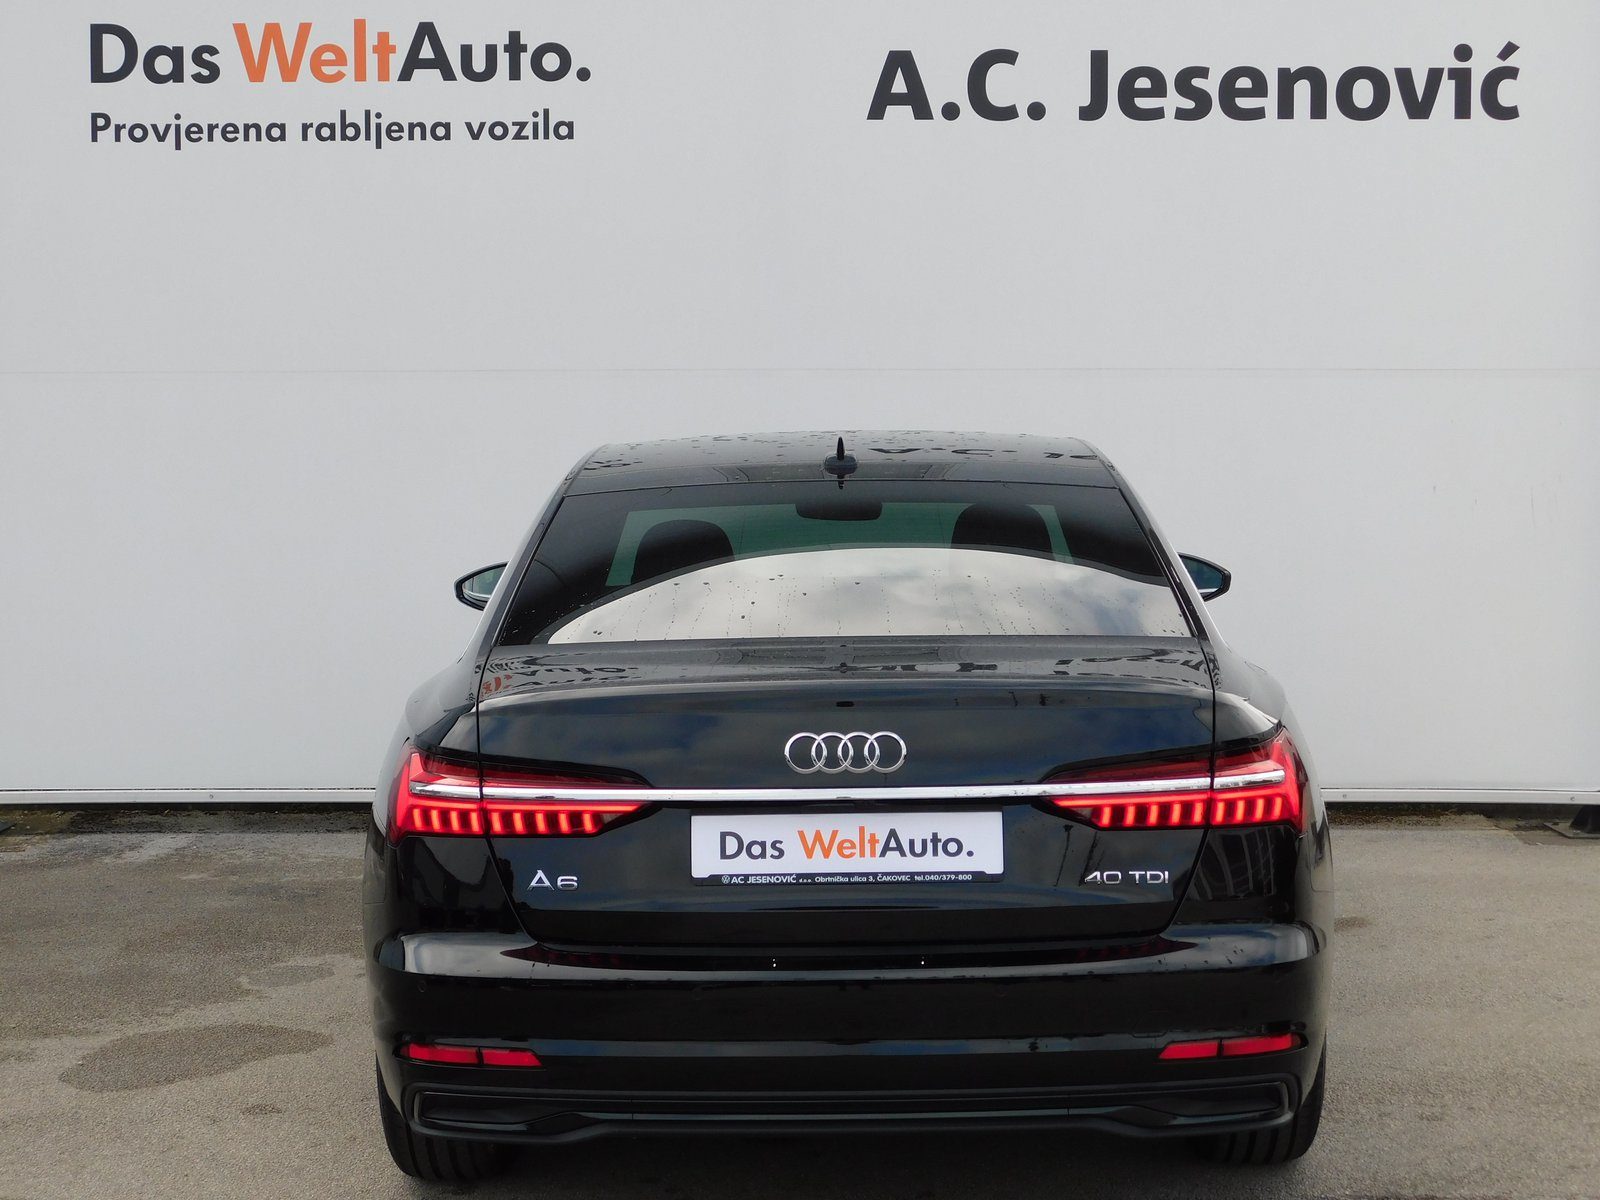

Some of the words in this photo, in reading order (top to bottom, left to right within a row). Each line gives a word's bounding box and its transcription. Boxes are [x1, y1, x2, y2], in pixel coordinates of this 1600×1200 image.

[89, 23, 221, 85] Das
[232, 18, 592, 84] WeltAuto.
[866, 48, 1047, 122] A.C.
[1078, 40, 1521, 122] Jesenović
[90, 112, 287, 151] Provjerena
[301, 109, 451, 150] rabljena
[464, 108, 576, 141] vozila
[719, 831, 785, 860] Das
[797, 825, 975, 860] WeltAuto.
[526, 869, 578, 891] A6
[730, 876, 745, 884] AC
[746, 873, 797, 884] JESENOVIĆ
[814, 875, 849, 883] Obrtnička
[877, 873, 911, 882] ČAKOVEC
[1084, 870, 1122, 885] 40
[1128, 870, 1169, 884] TDI
